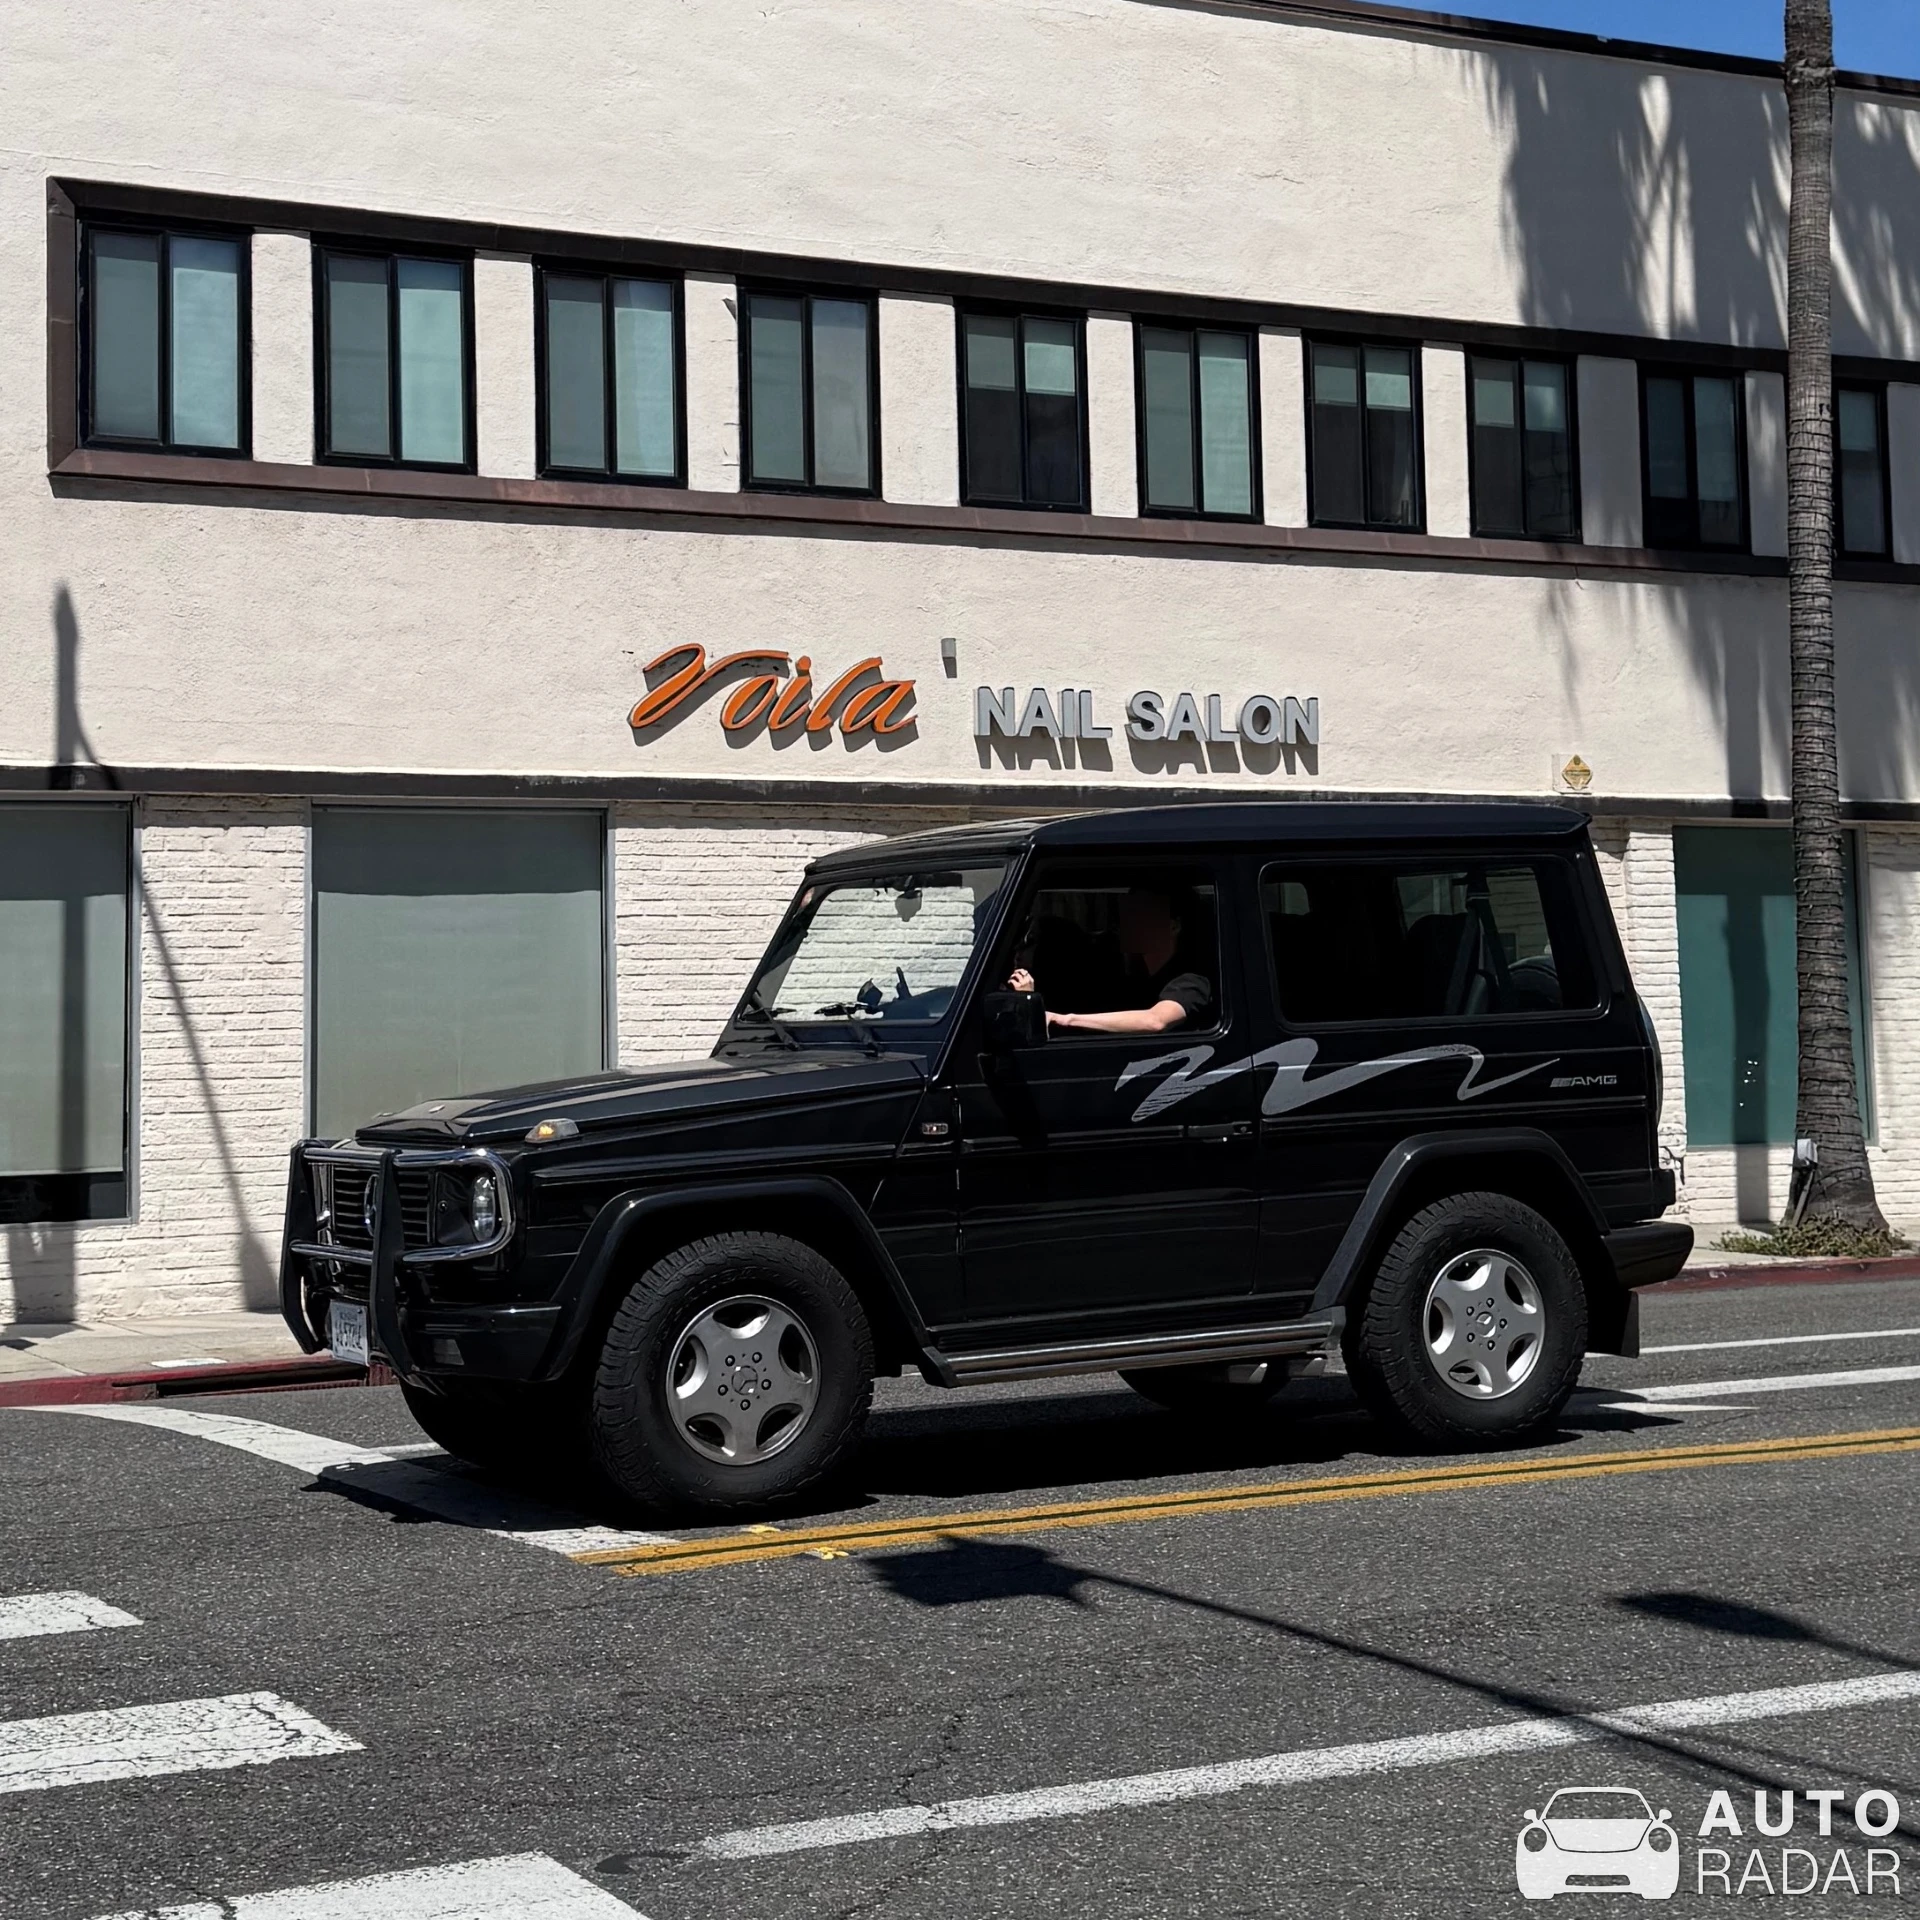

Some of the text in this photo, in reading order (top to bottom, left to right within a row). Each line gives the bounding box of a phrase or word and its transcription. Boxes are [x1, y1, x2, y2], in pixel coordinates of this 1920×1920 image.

[974, 685, 1113, 739] NAIL
[1125, 690, 1319, 745] SALON
[1570, 1075, 1617, 1087] AMG
